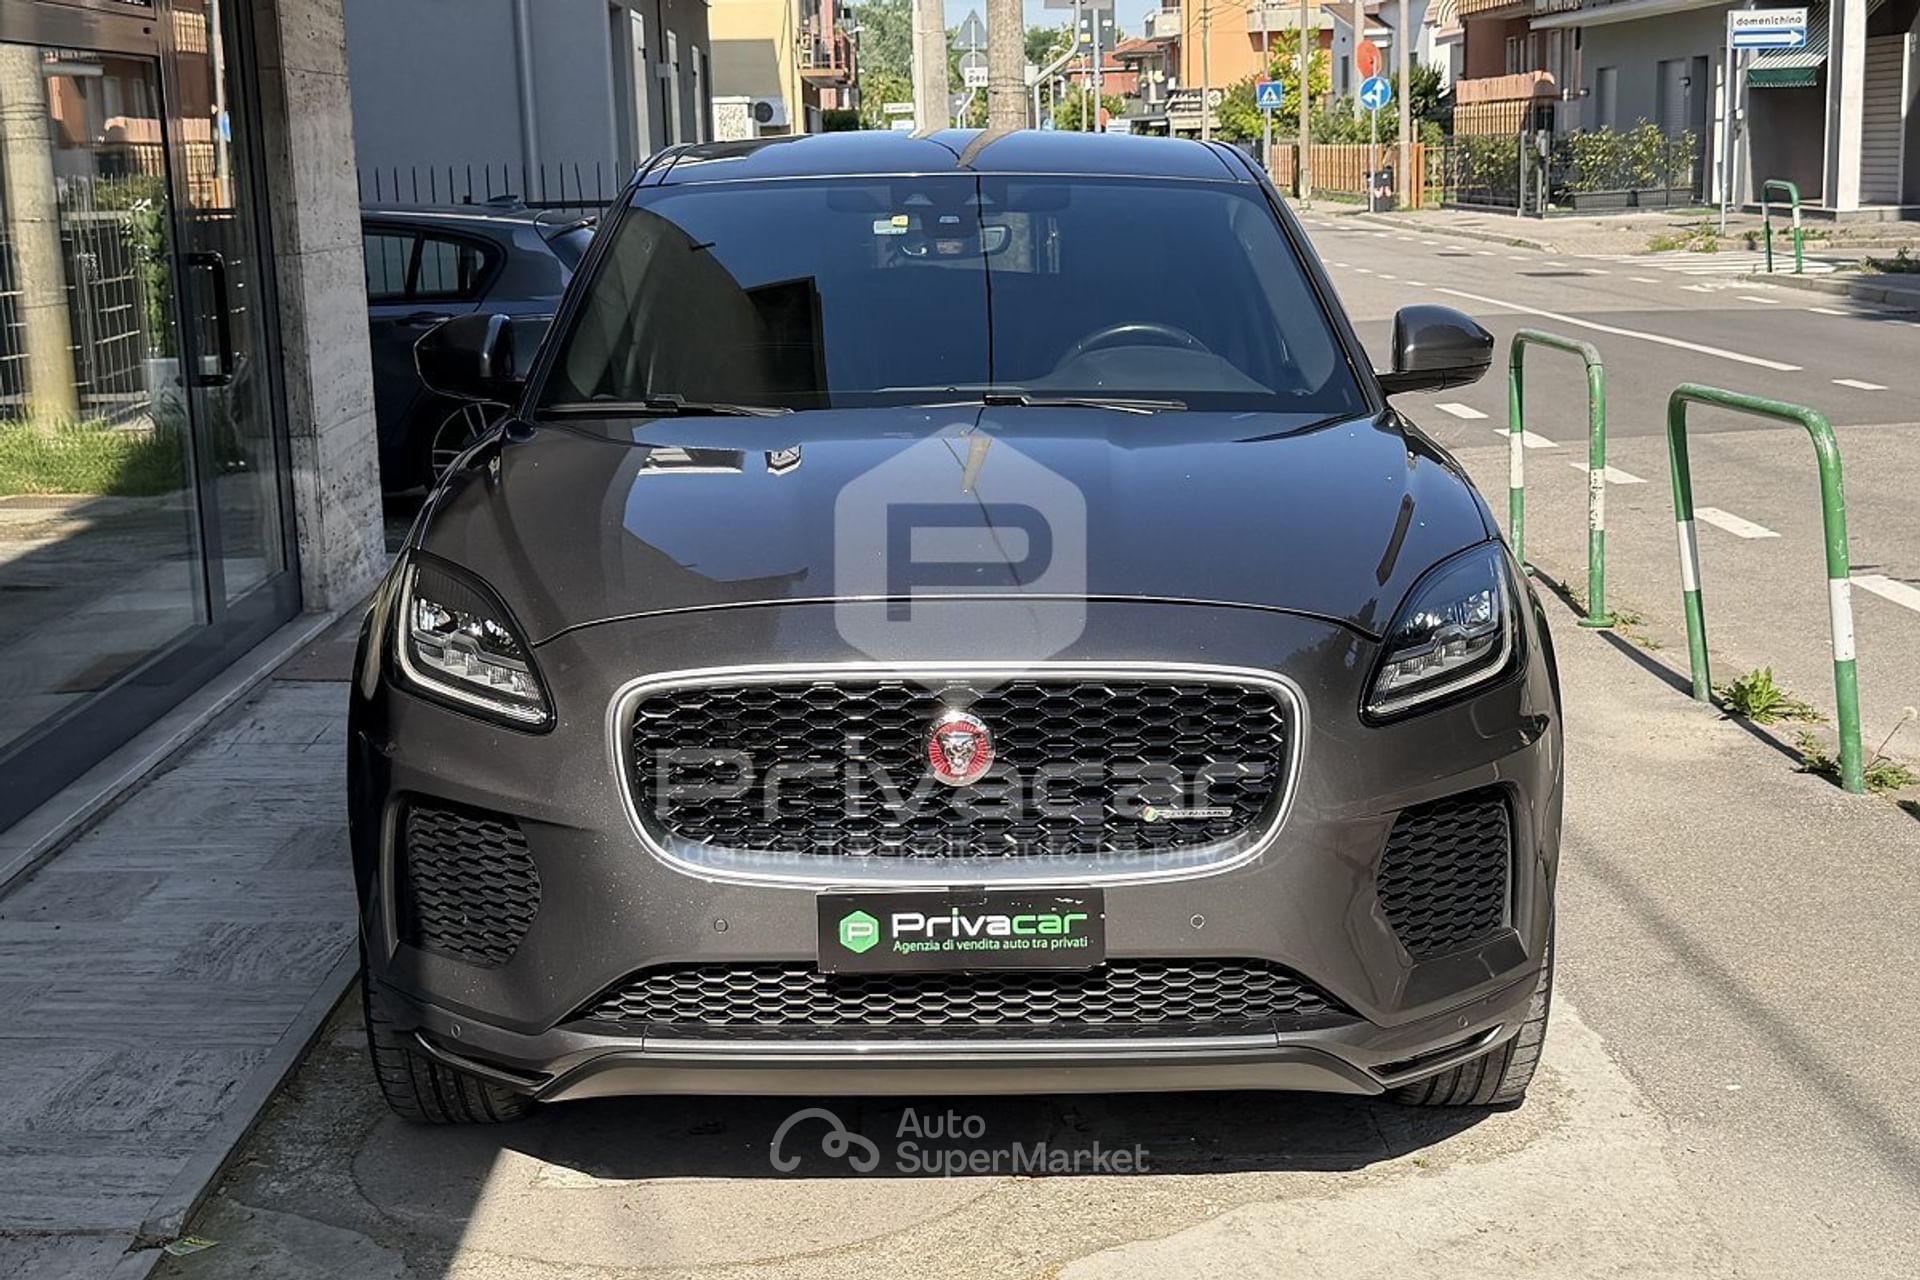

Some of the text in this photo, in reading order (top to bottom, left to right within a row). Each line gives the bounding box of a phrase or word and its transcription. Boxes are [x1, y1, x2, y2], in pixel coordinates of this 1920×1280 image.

[892, 908, 1087, 938] Privacar
[893, 936, 1088, 954] Agenzia di vendita auto tra privati
